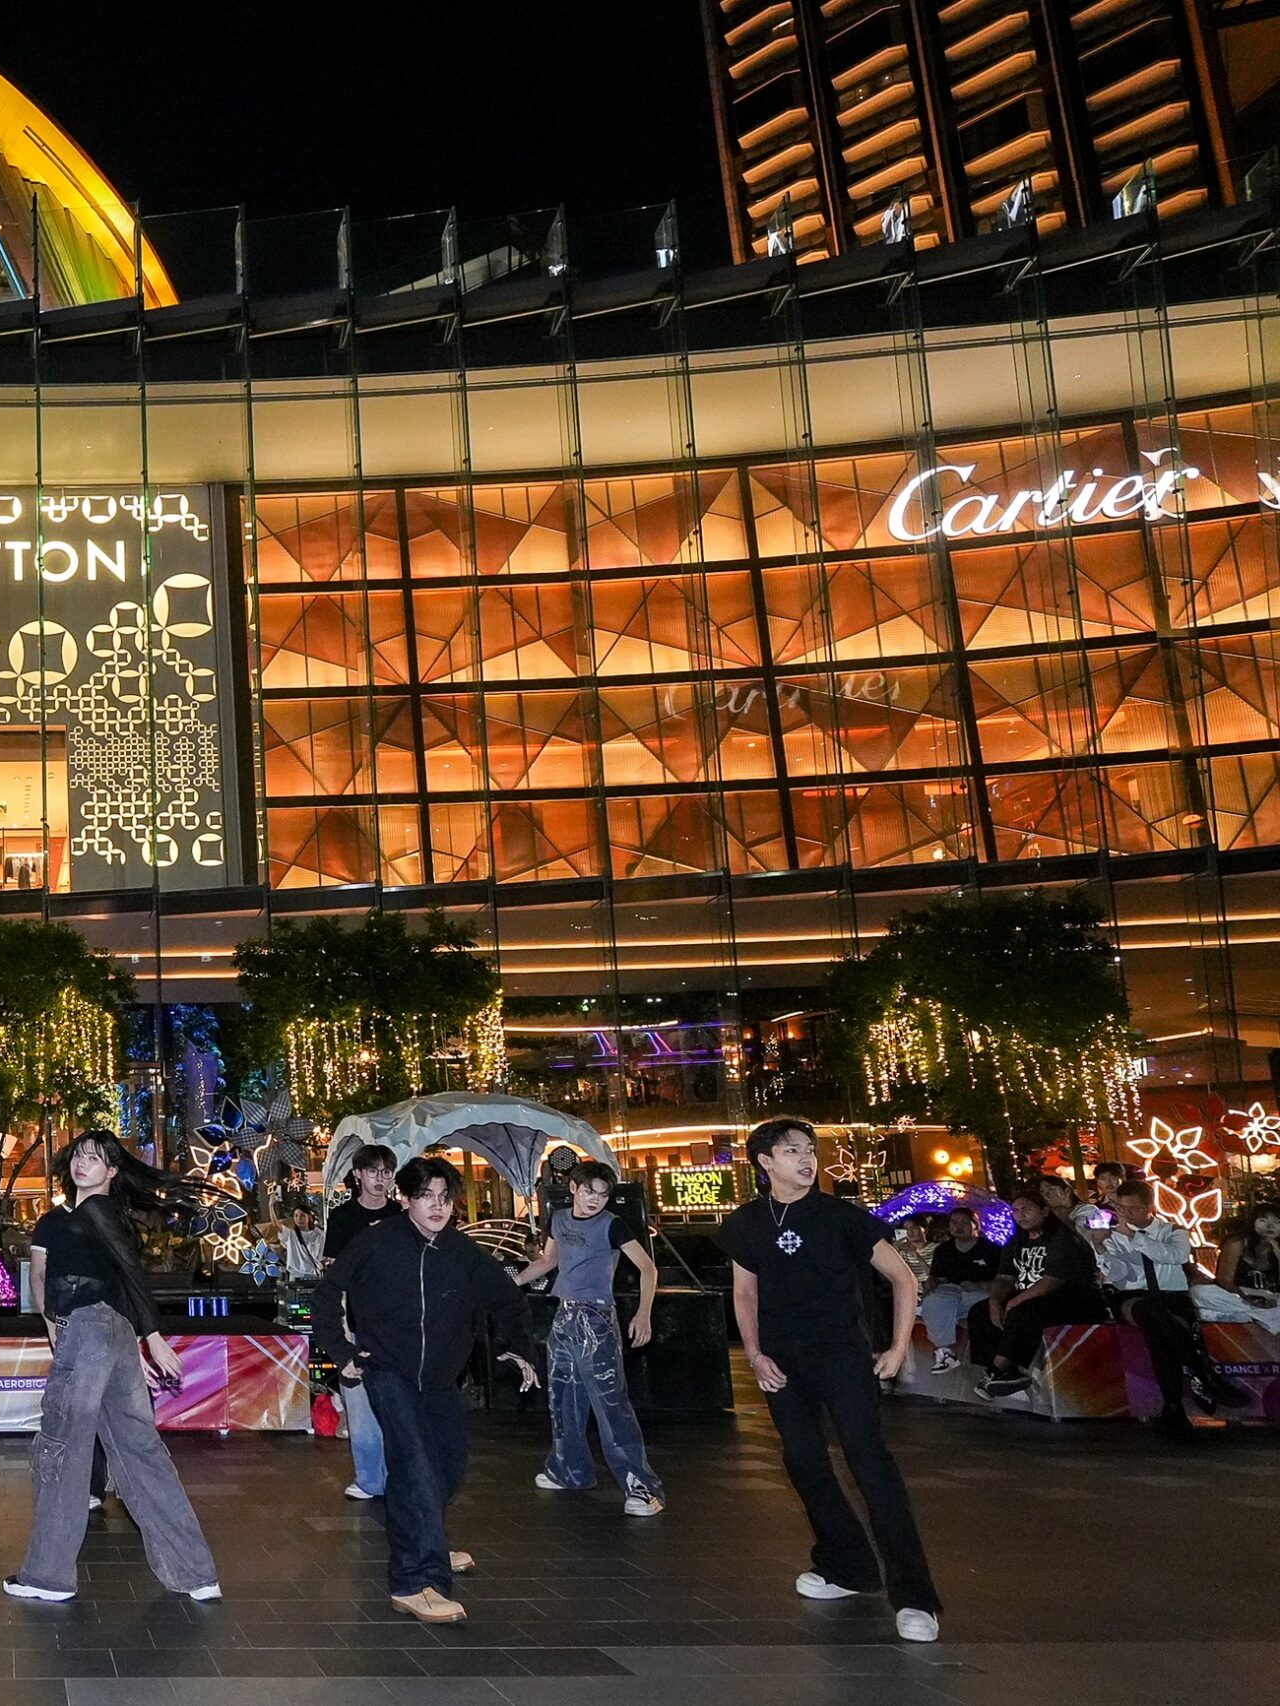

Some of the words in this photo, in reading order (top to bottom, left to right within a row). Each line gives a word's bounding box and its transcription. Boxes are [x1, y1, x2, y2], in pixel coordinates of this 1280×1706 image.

[887, 460, 1200, 541] Cartier
[677, 1191, 720, 1205] HOUSE
[1224, 1365, 1260, 1374] DANCE
